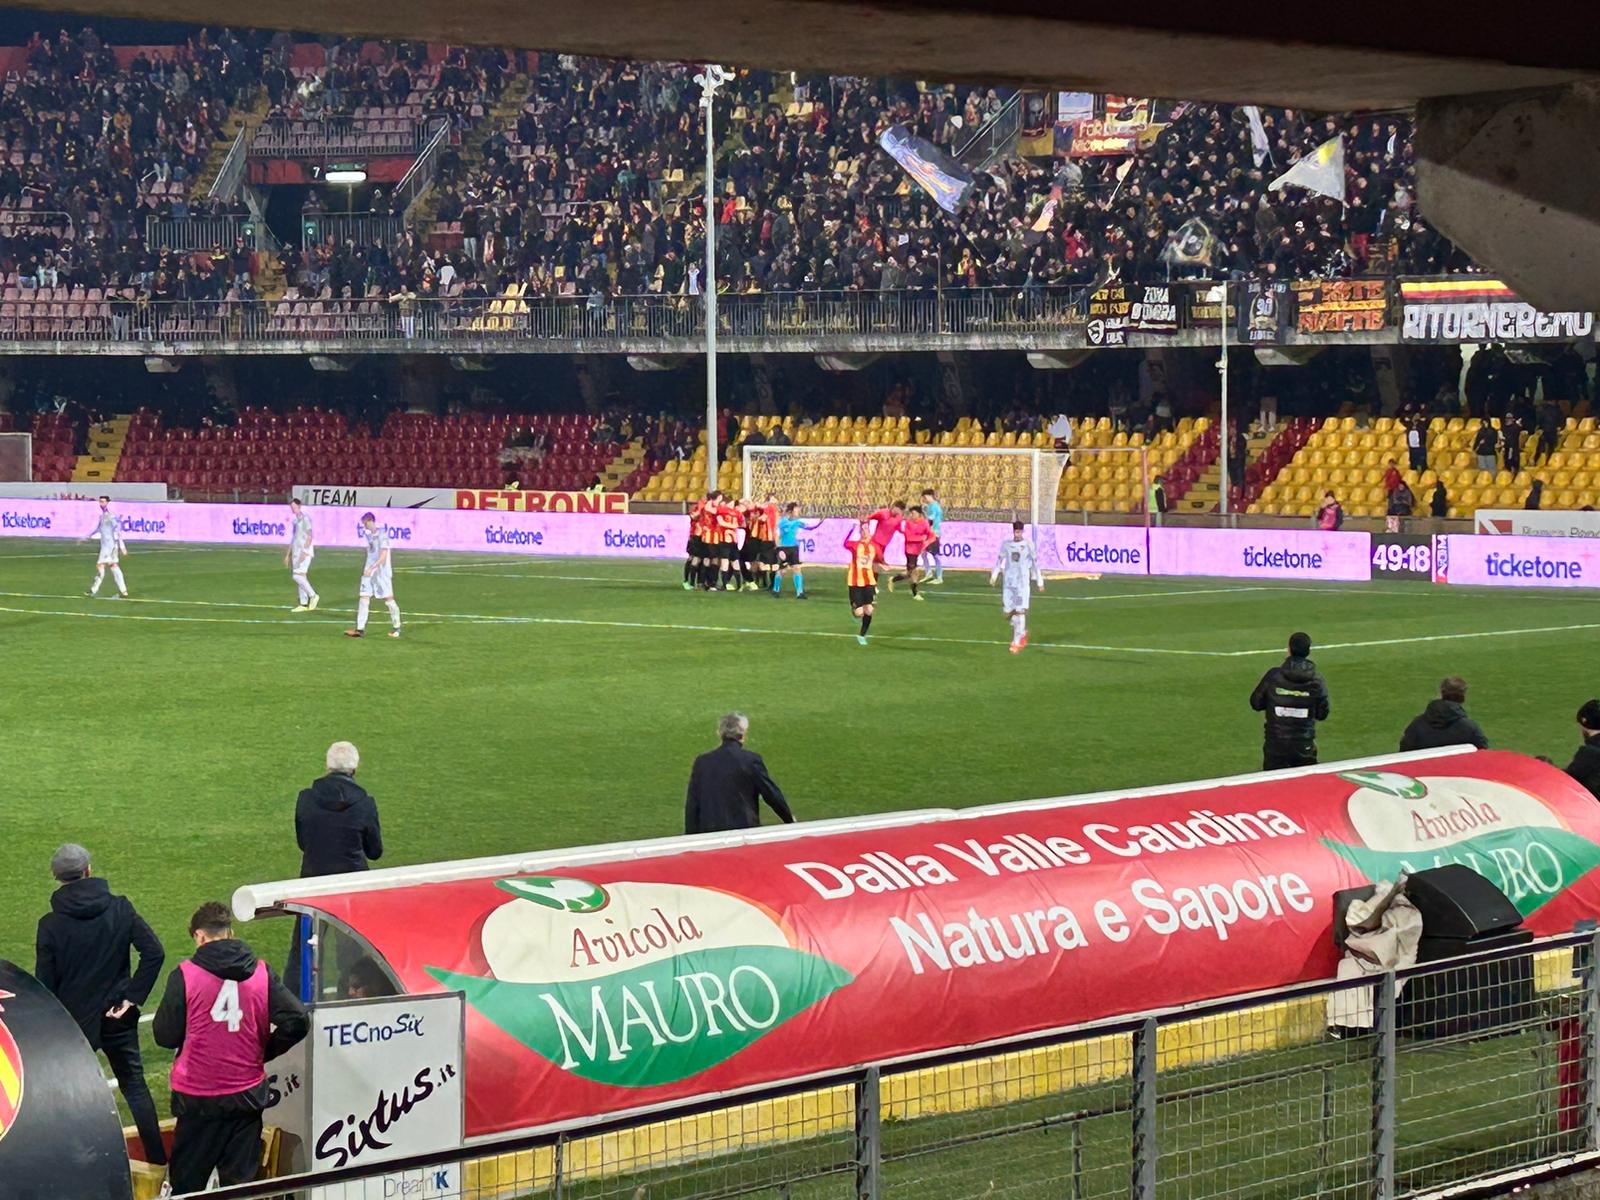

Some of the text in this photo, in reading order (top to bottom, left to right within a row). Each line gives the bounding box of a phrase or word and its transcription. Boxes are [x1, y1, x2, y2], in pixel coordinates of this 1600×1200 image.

[312, 488, 357, 506] TEAM
[2, 511, 51, 529] ticketone
[232, 517, 286, 536] ticketone
[485, 525, 544, 546] ticketone
[604, 528, 666, 549] ticketone
[1066, 541, 1141, 564] ticketone
[1243, 545, 1323, 569] ticketone
[1372, 544, 1431, 573] 49:18
[1485, 551, 1583, 579] ticketone
[1411, 795, 1500, 843] Avicola
[785, 808, 1305, 901] Dalla Valle Caudina
[890, 870, 1314, 975] Natura e Sapore
[569, 907, 703, 968] Avicola
[209, 980, 243, 1033] 4
[539, 964, 781, 1070] MAURO
[315, 1064, 456, 1168] Sixtus.it
